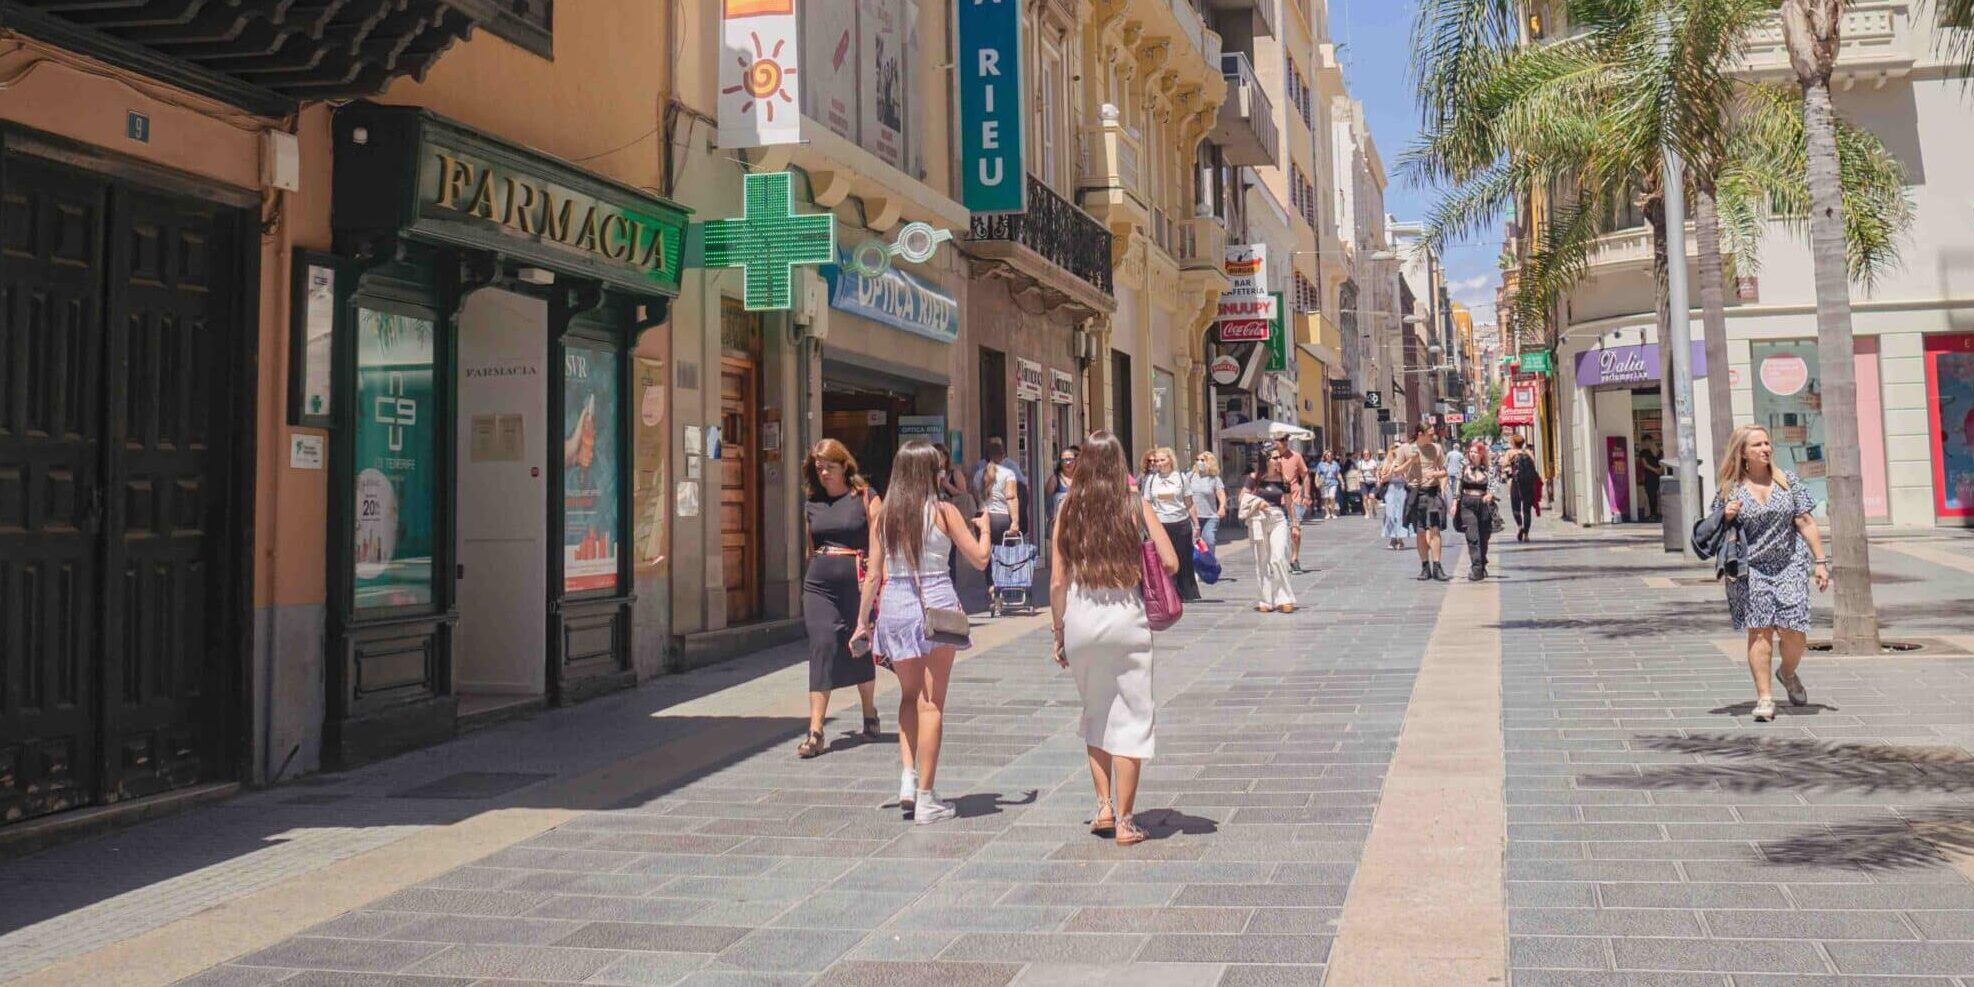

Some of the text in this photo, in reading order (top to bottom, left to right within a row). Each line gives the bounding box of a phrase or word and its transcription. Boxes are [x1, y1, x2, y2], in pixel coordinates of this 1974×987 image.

[135, 117, 142, 139] 9
[978, 48, 1004, 187] RIEU
[433, 154, 667, 273] FARMACIA
[1234, 279, 1252, 288] BAR
[918, 289, 950, 332] RIEU
[1223, 321, 1266, 337] Coca-Cola
[466, 364, 538, 378] FARMACIA
[565, 354, 587, 379] SVR
[1600, 351, 1645, 374] Dalia
